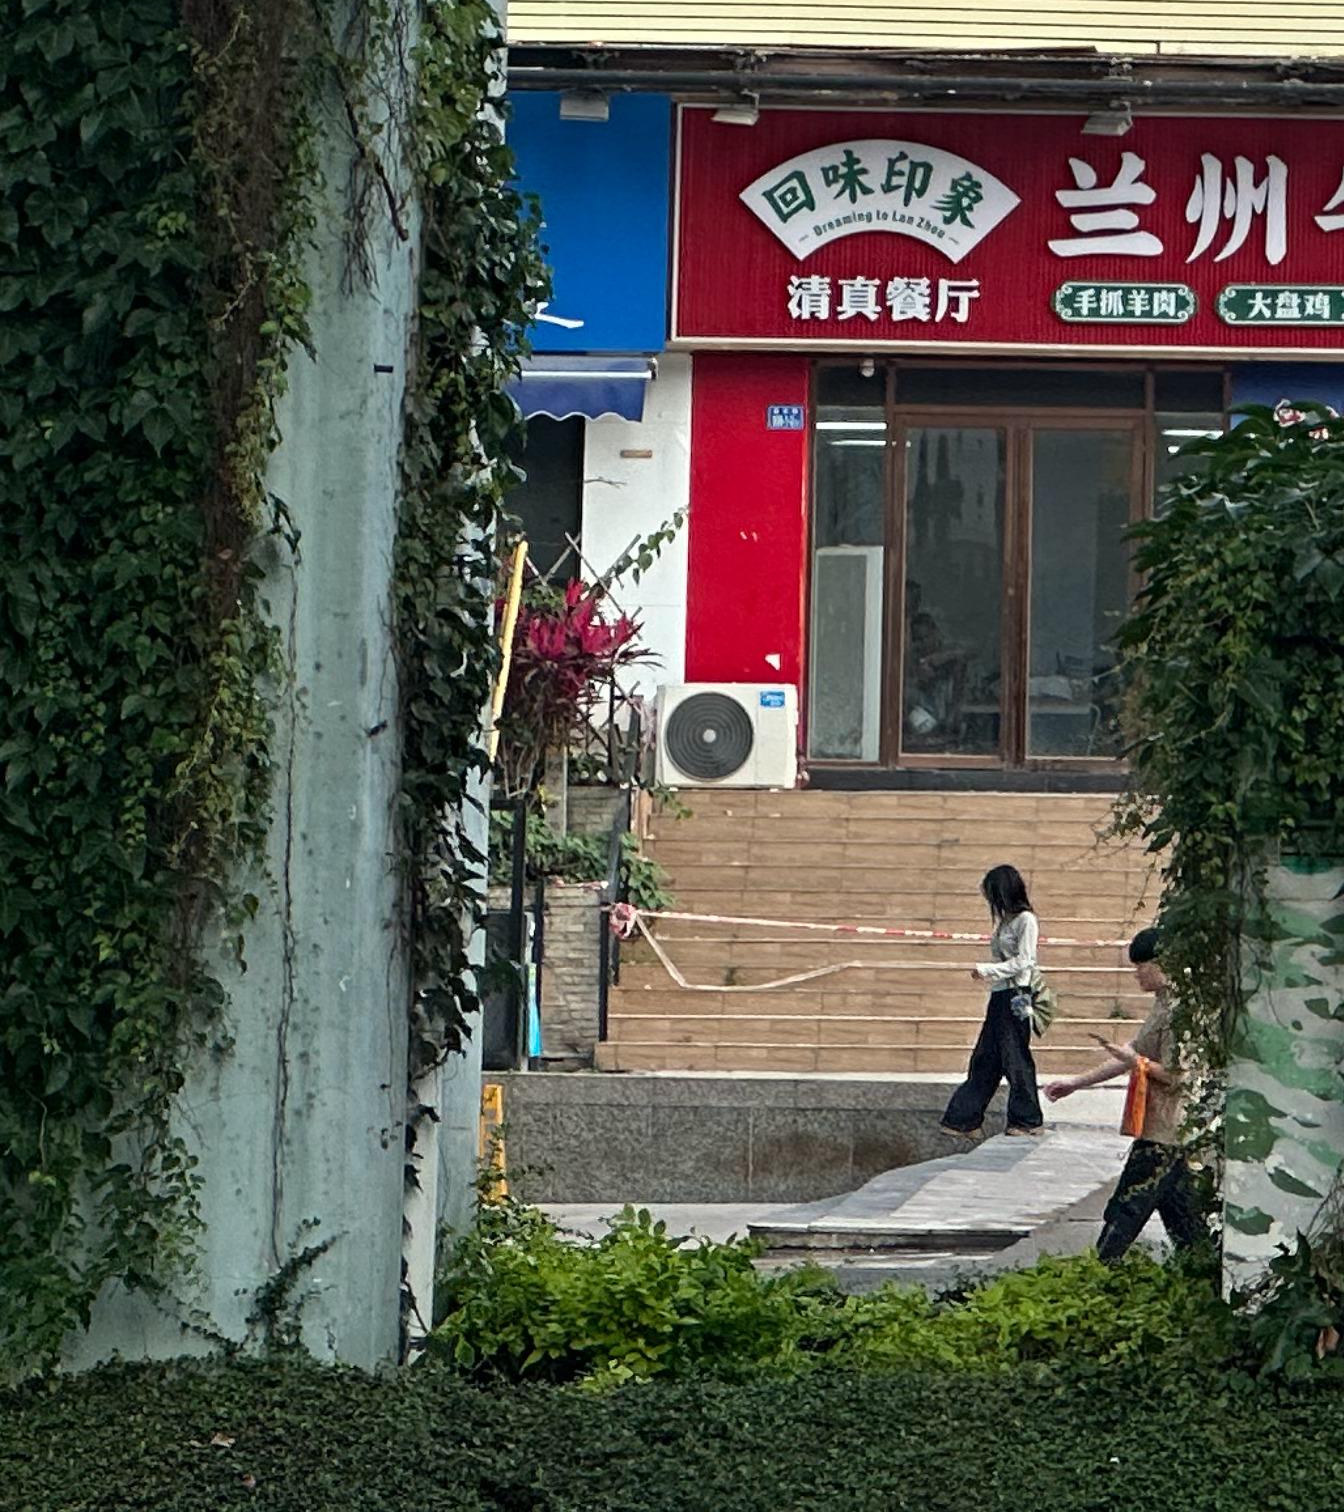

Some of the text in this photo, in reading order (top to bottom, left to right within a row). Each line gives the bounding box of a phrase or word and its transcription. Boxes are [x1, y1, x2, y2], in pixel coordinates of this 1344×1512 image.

[760, 148, 985, 229] 回味印象
[812, 208, 946, 240] Dreaming to Lan Zhou
[786, 274, 982, 323] 清真餐厅
[1073, 287, 1180, 318] 手抓羊肉
[1246, 291, 1332, 320] 大盘鸡
